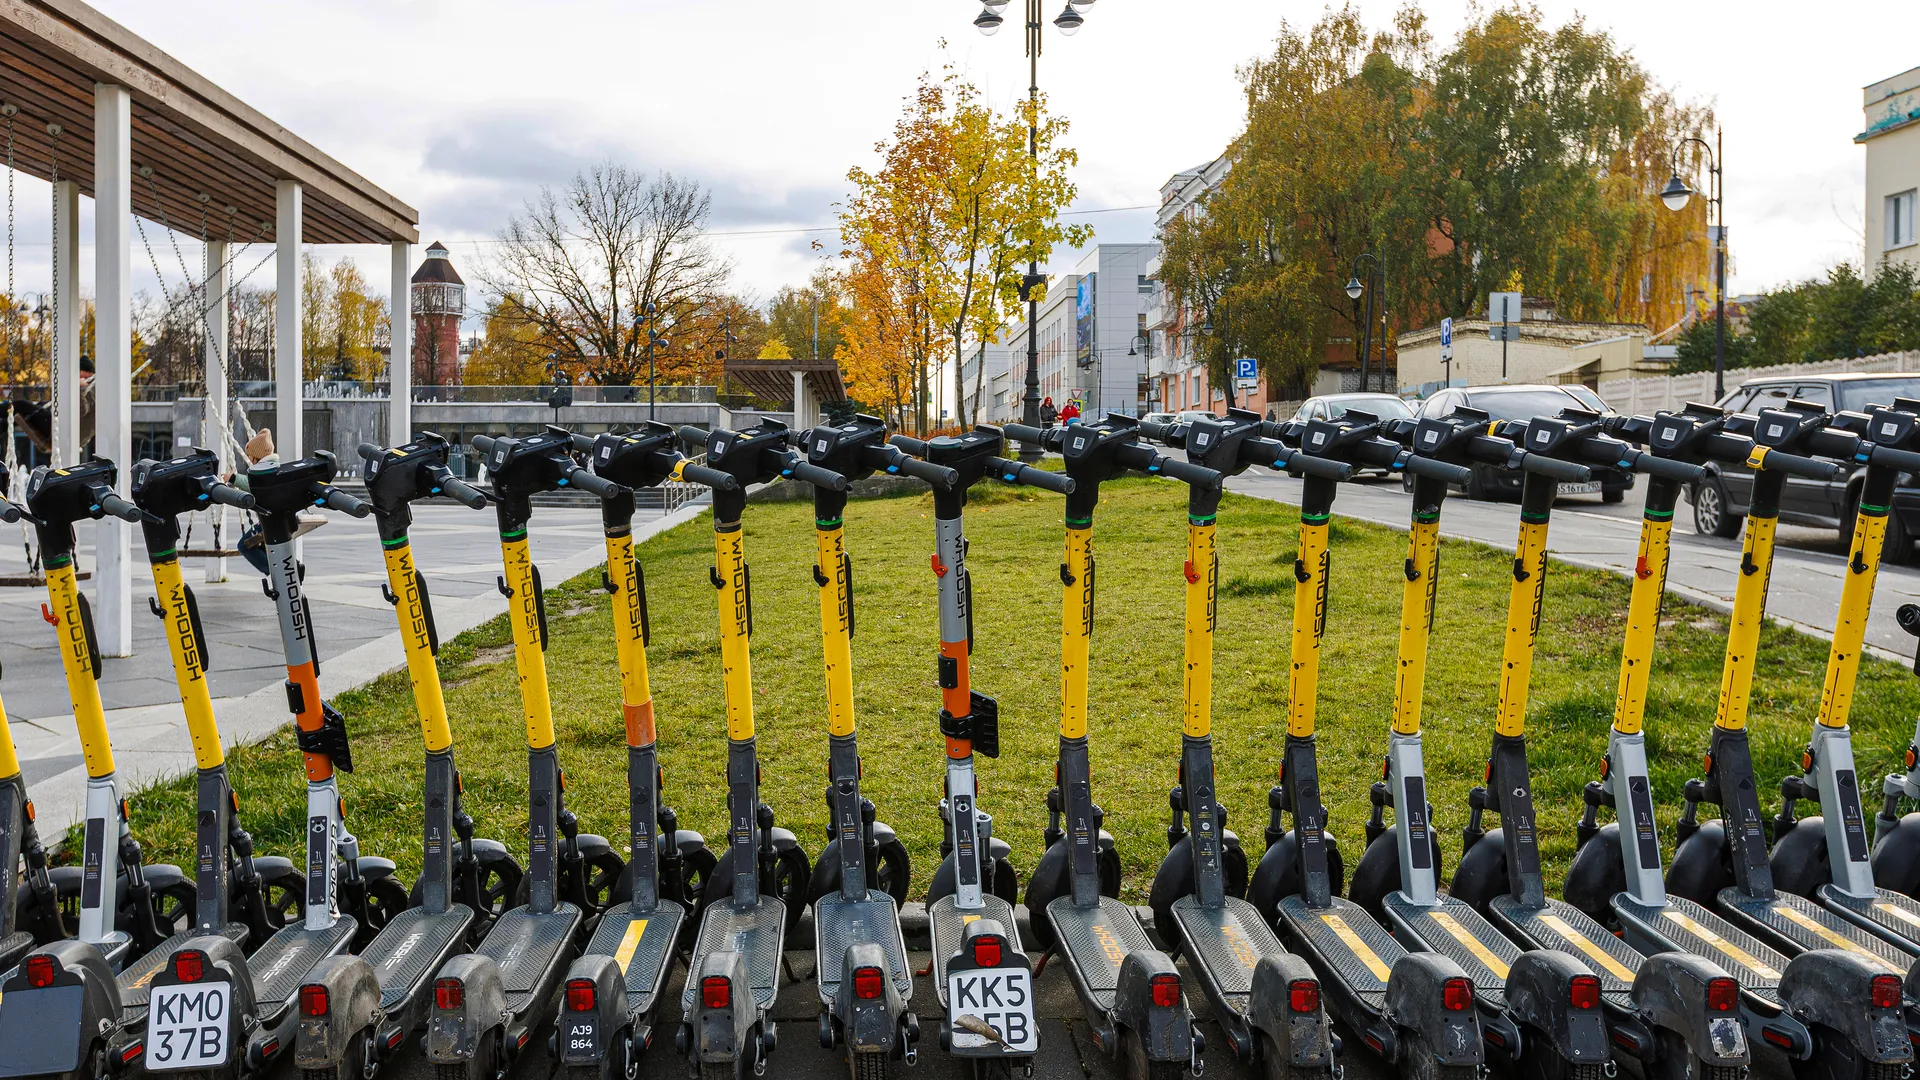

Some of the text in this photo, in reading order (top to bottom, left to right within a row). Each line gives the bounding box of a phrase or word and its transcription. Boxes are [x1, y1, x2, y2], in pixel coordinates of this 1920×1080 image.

[1240, 361, 1251, 376] P
[282, 555, 306, 640] WHOOSH
[399, 552, 428, 649] WHOOSH
[516, 546, 540, 645] WHOOSH
[622, 543, 642, 640] WHOOSH
[731, 538, 747, 637] WHOOSH
[834, 534, 849, 632] WHOOSH
[955, 534, 965, 618] WHOOSH
[1082, 538, 1092, 637] WHOOSH
[1312, 549, 1329, 648] WHOOSH
[171, 583, 201, 681] WHOOSH
[157, 989, 223, 1025] KM0
[571, 1025, 593, 1035] AJ9
[956, 975, 1026, 1008] KK5
[966, 1012, 1028, 1044] 5B
[155, 1026, 222, 1062] 37B
[571, 1039, 593, 1049] 864
